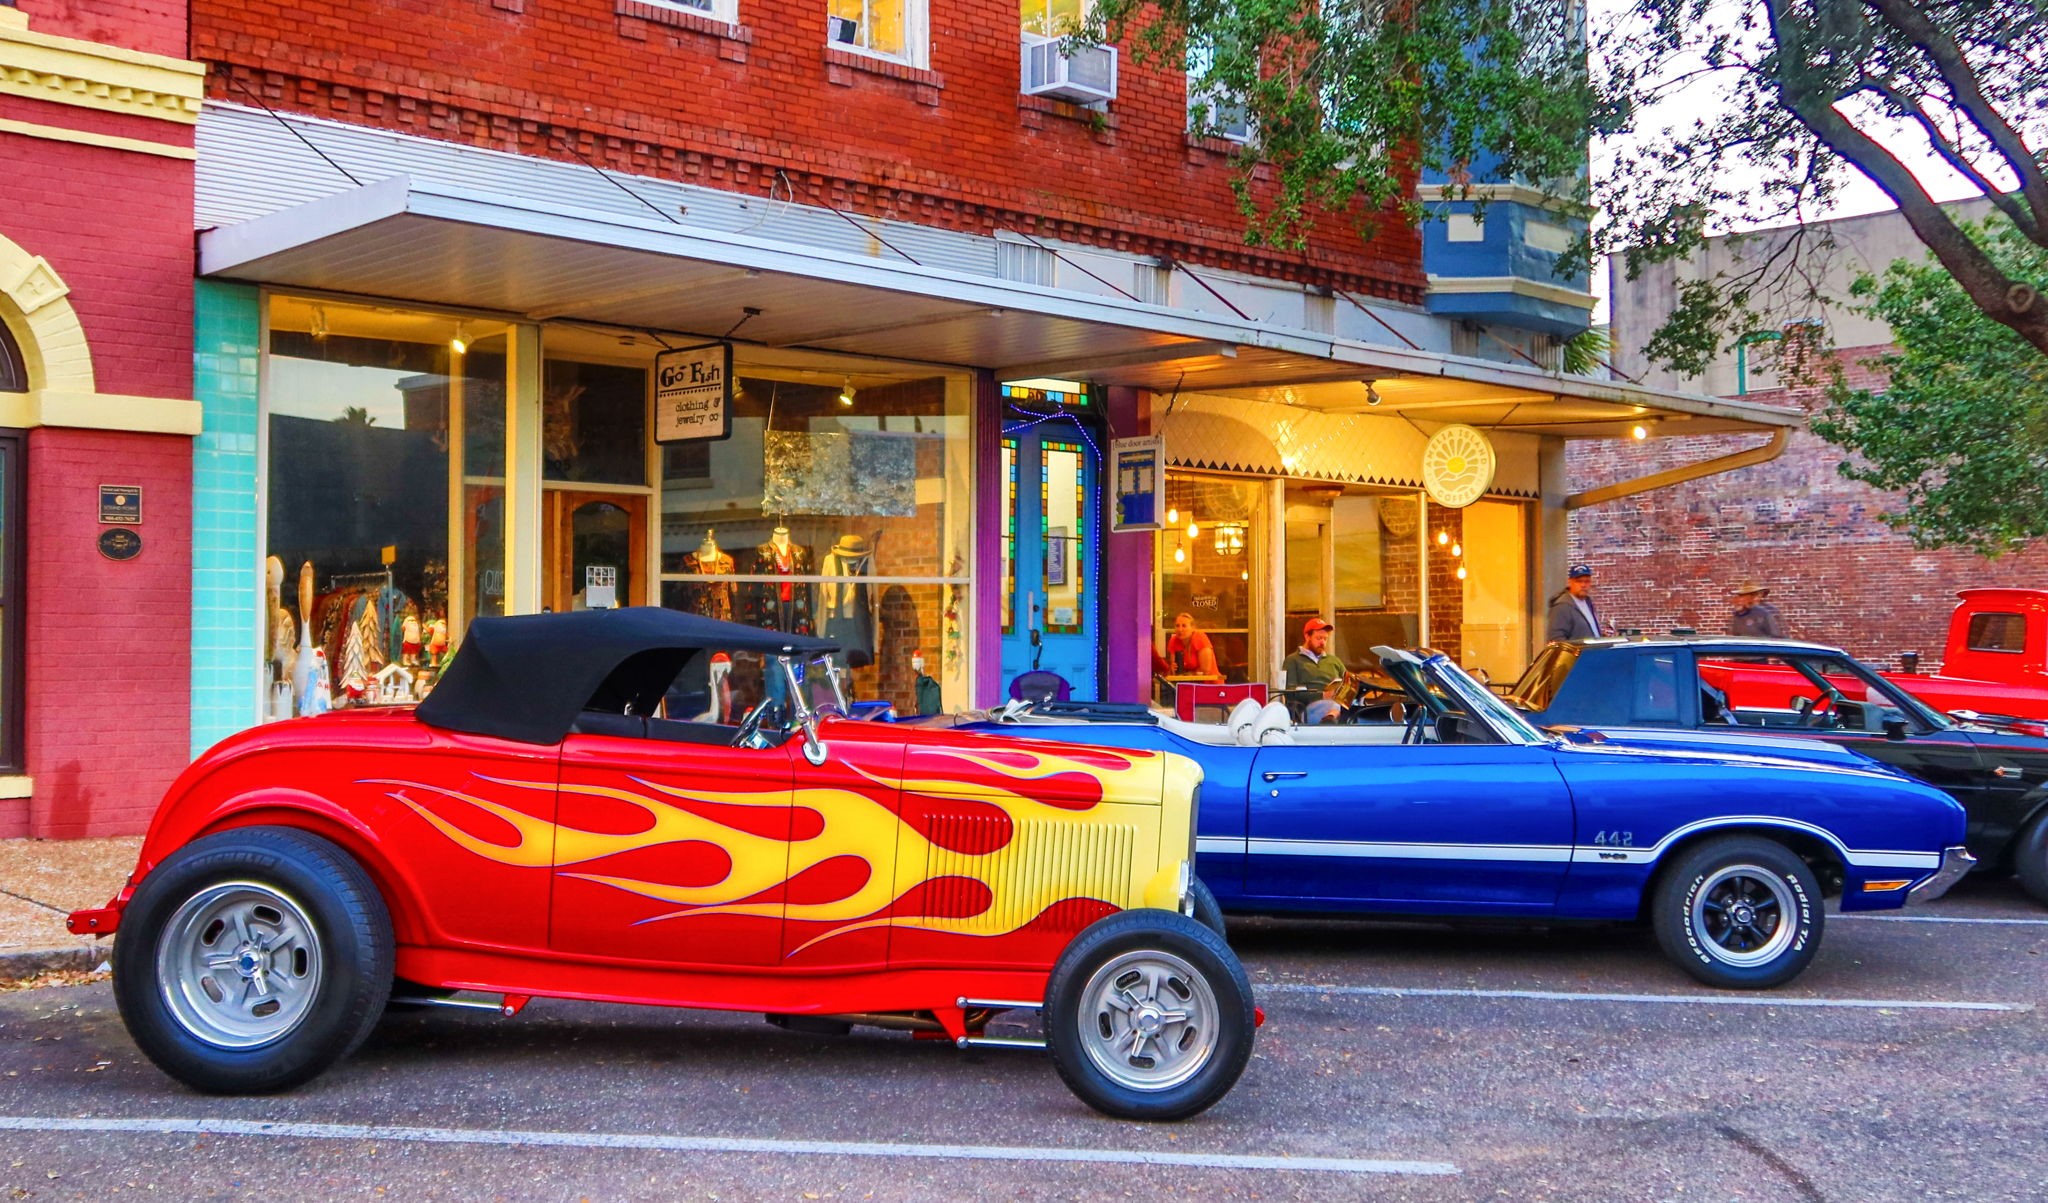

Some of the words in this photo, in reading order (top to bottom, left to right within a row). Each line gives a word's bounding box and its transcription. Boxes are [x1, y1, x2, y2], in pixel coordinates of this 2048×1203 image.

[689, 361, 720, 384] Fish
[676, 401, 709, 412] clothing
[675, 413, 705, 428] jewelry
[1425, 430, 1454, 466] AMELIA
[1459, 429, 1487, 465] ISLAND
[1437, 487, 1476, 501] COFFEE
[1192, 599, 1217, 608] CLOSED
[1594, 830, 1633, 847] 442
[1786, 873, 1811, 925] Radial
[1682, 874, 1711, 964] BFGoodrich
[1793, 929, 1809, 951] T/A
